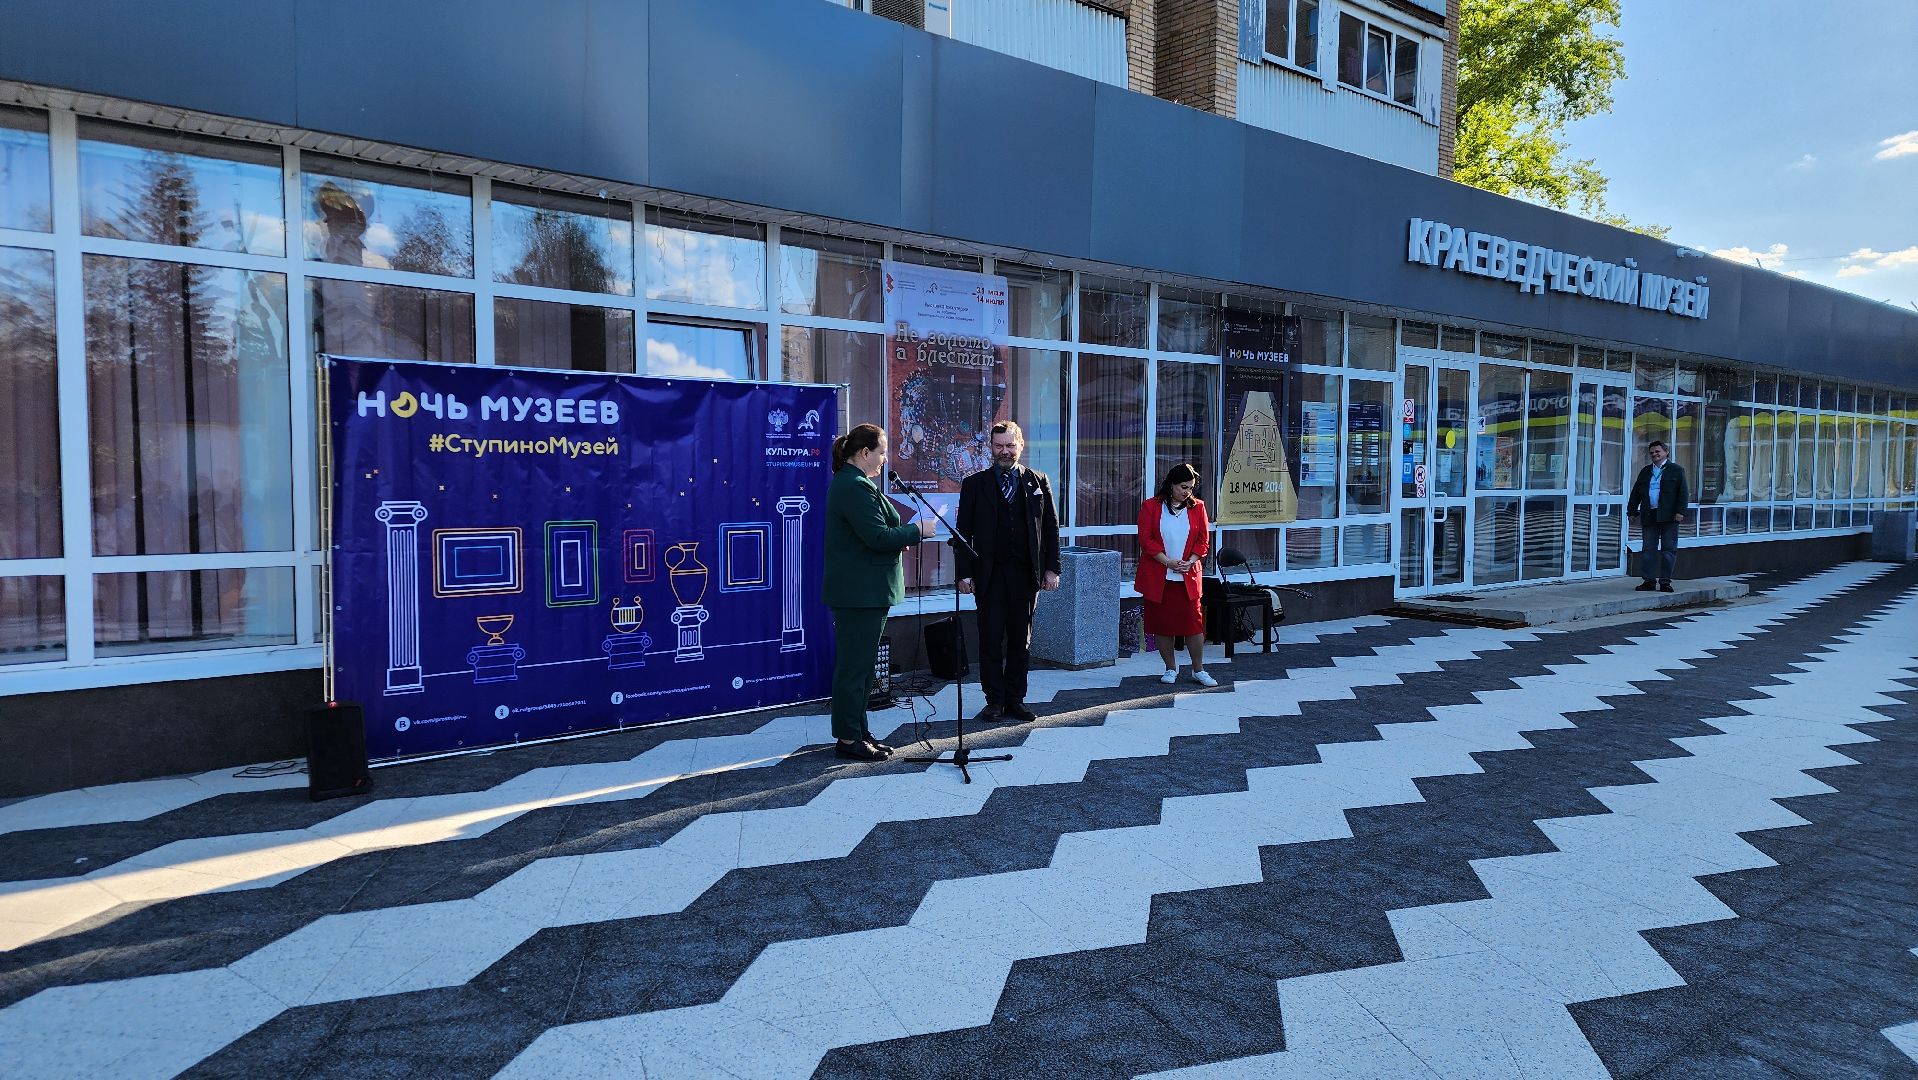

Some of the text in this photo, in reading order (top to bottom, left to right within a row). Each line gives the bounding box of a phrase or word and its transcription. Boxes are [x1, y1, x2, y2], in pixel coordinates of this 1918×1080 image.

[1408, 217, 1709, 320] КРАЕВЕДЧЕСКИЙ МУЗЕЙ
[896, 321, 919, 342] Не
[896, 342, 995, 367] а блестит
[1229, 348, 1289, 363] НОЧЬ МУЗЕЕВ
[357, 390, 619, 426] НОЧЬ МУЗЕЕВ
[428, 433, 619, 459] #СтупиноМузей
[765, 447, 821, 457] КУЛЬТУРА.РФ
[1229, 481, 1284, 494] 18 МАЯ 2024
